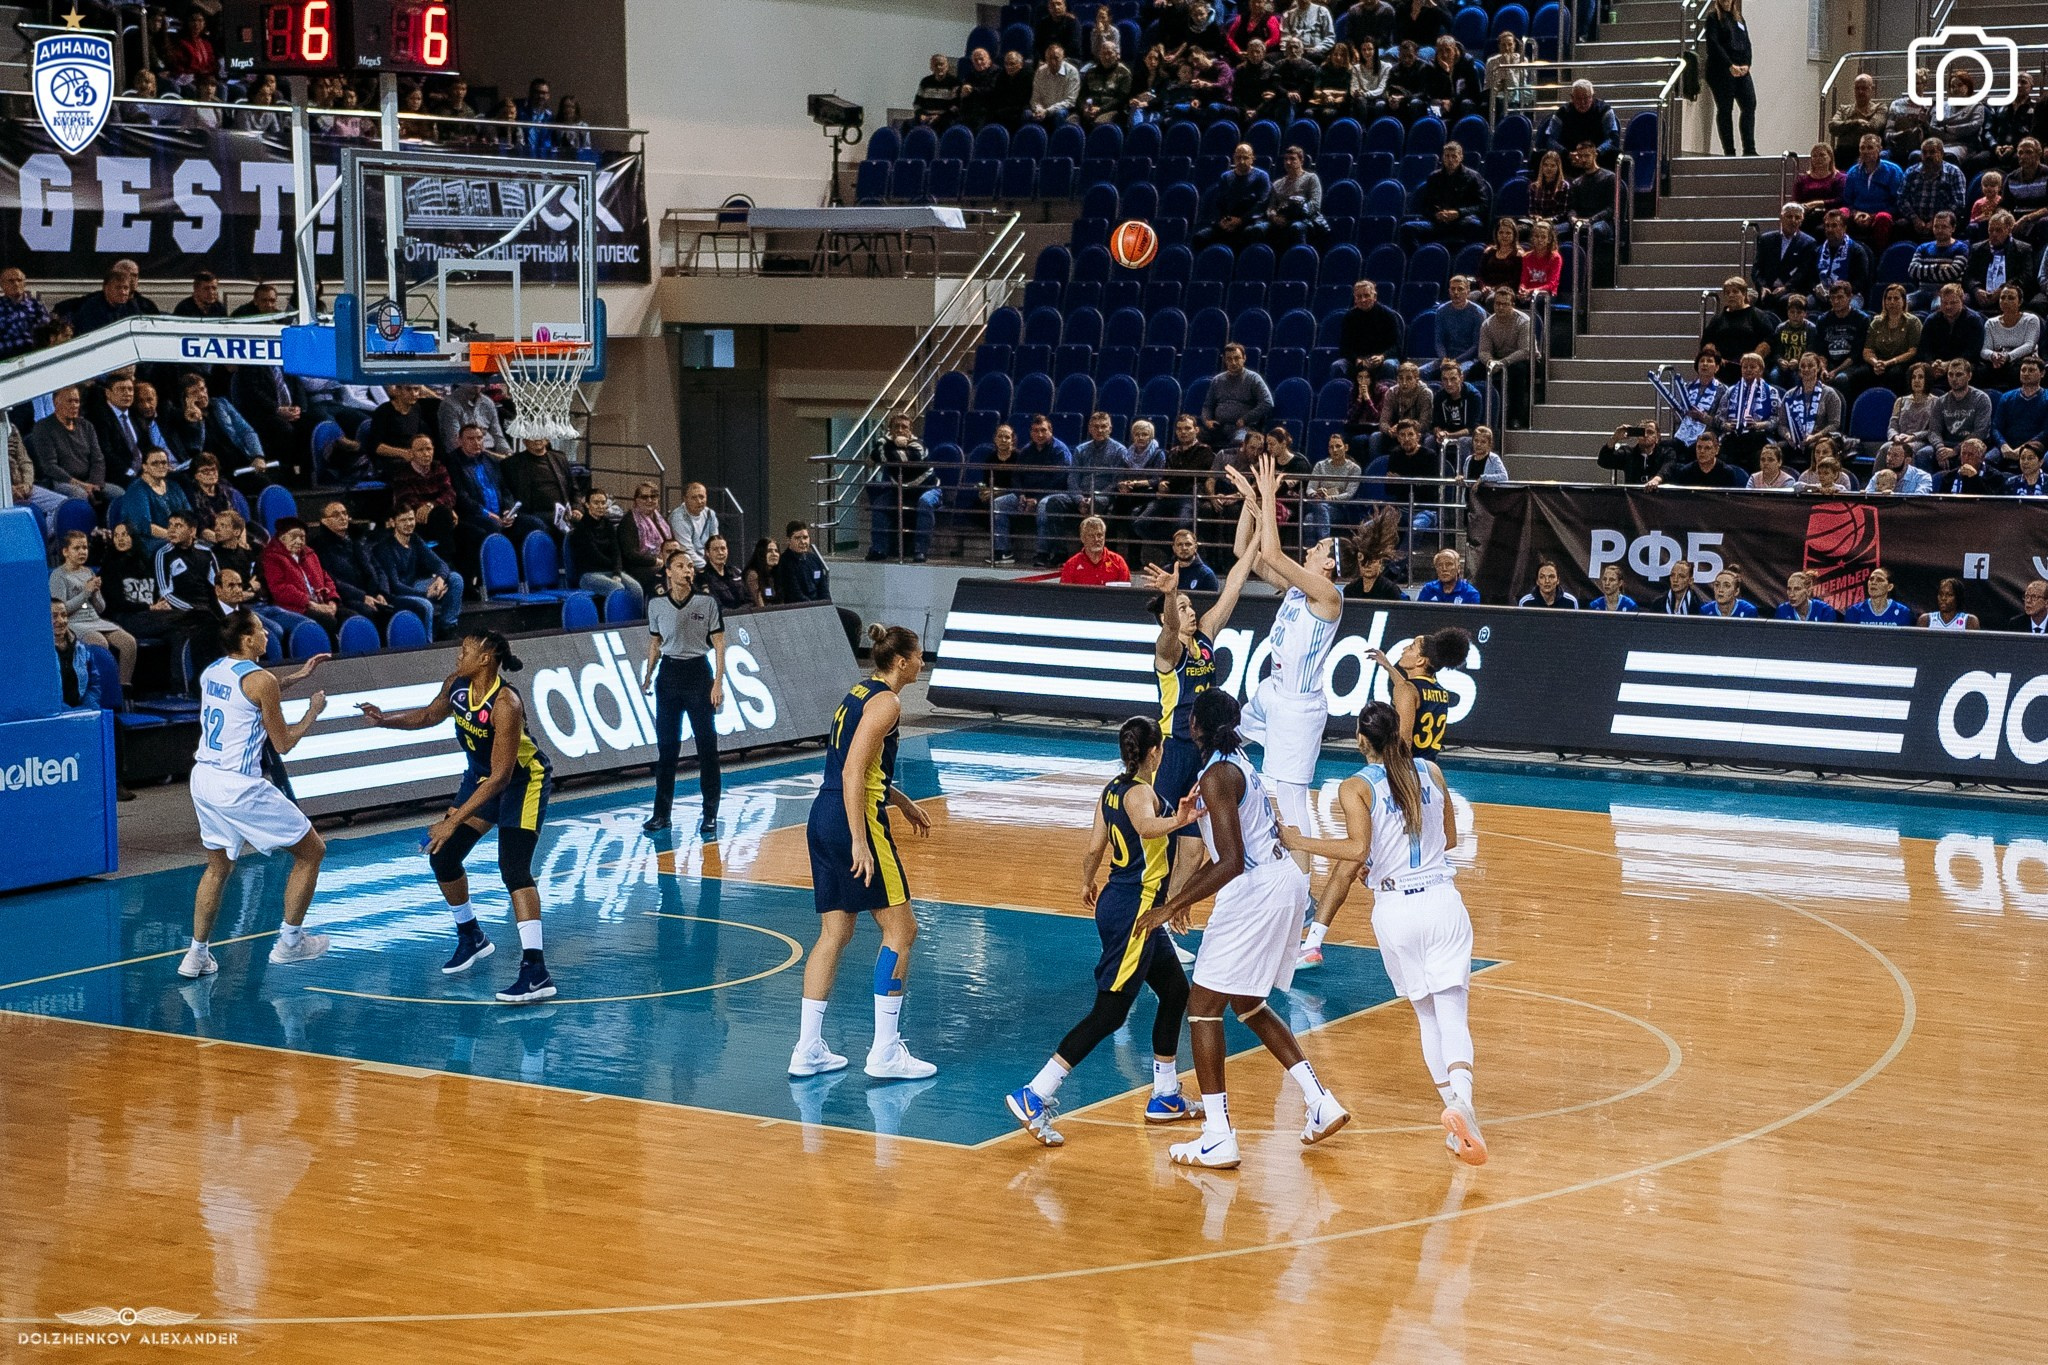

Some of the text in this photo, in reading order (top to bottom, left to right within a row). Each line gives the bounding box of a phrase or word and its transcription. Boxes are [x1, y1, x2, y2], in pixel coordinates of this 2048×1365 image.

[302, 1, 330, 60] 6
[422, 7, 448, 65] 6
[1588, 529, 1724, 584] РФБ
[204, 705, 225, 752] 12
[1413, 711, 1447, 750] 32
[0, 757, 79, 791] olten
